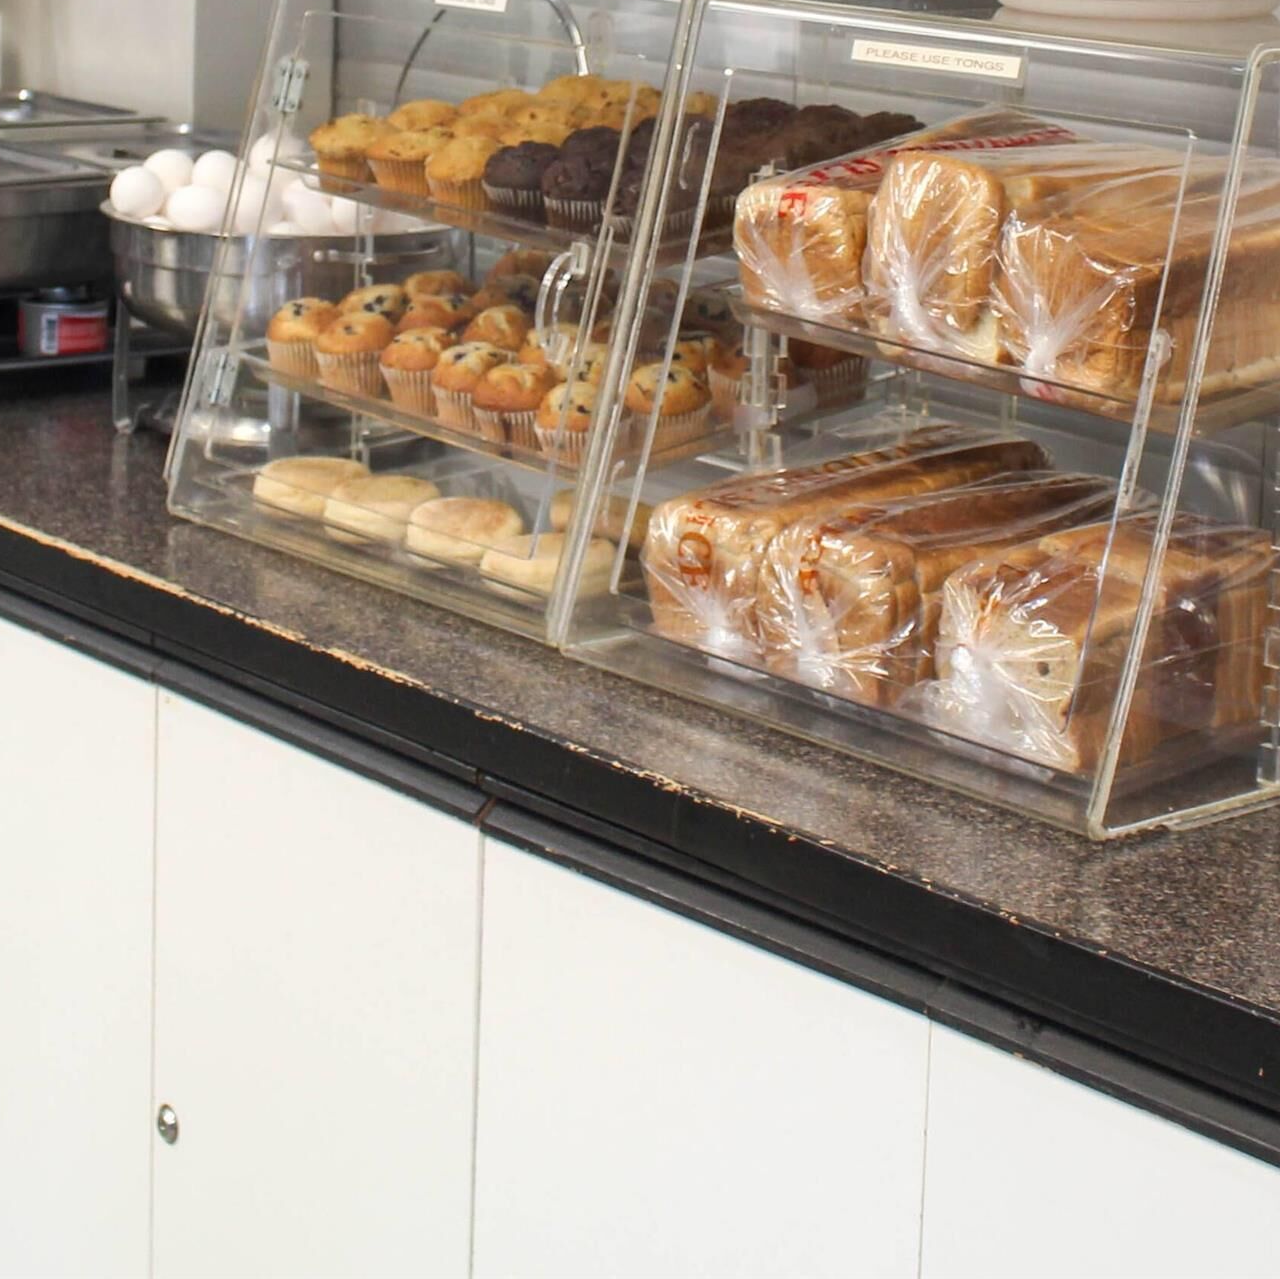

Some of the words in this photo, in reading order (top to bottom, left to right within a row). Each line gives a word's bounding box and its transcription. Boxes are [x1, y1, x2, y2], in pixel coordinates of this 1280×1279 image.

[865, 47, 920, 62] PLEASE
[922, 55, 951, 65] USE
[954, 57, 1005, 72] TONGS
